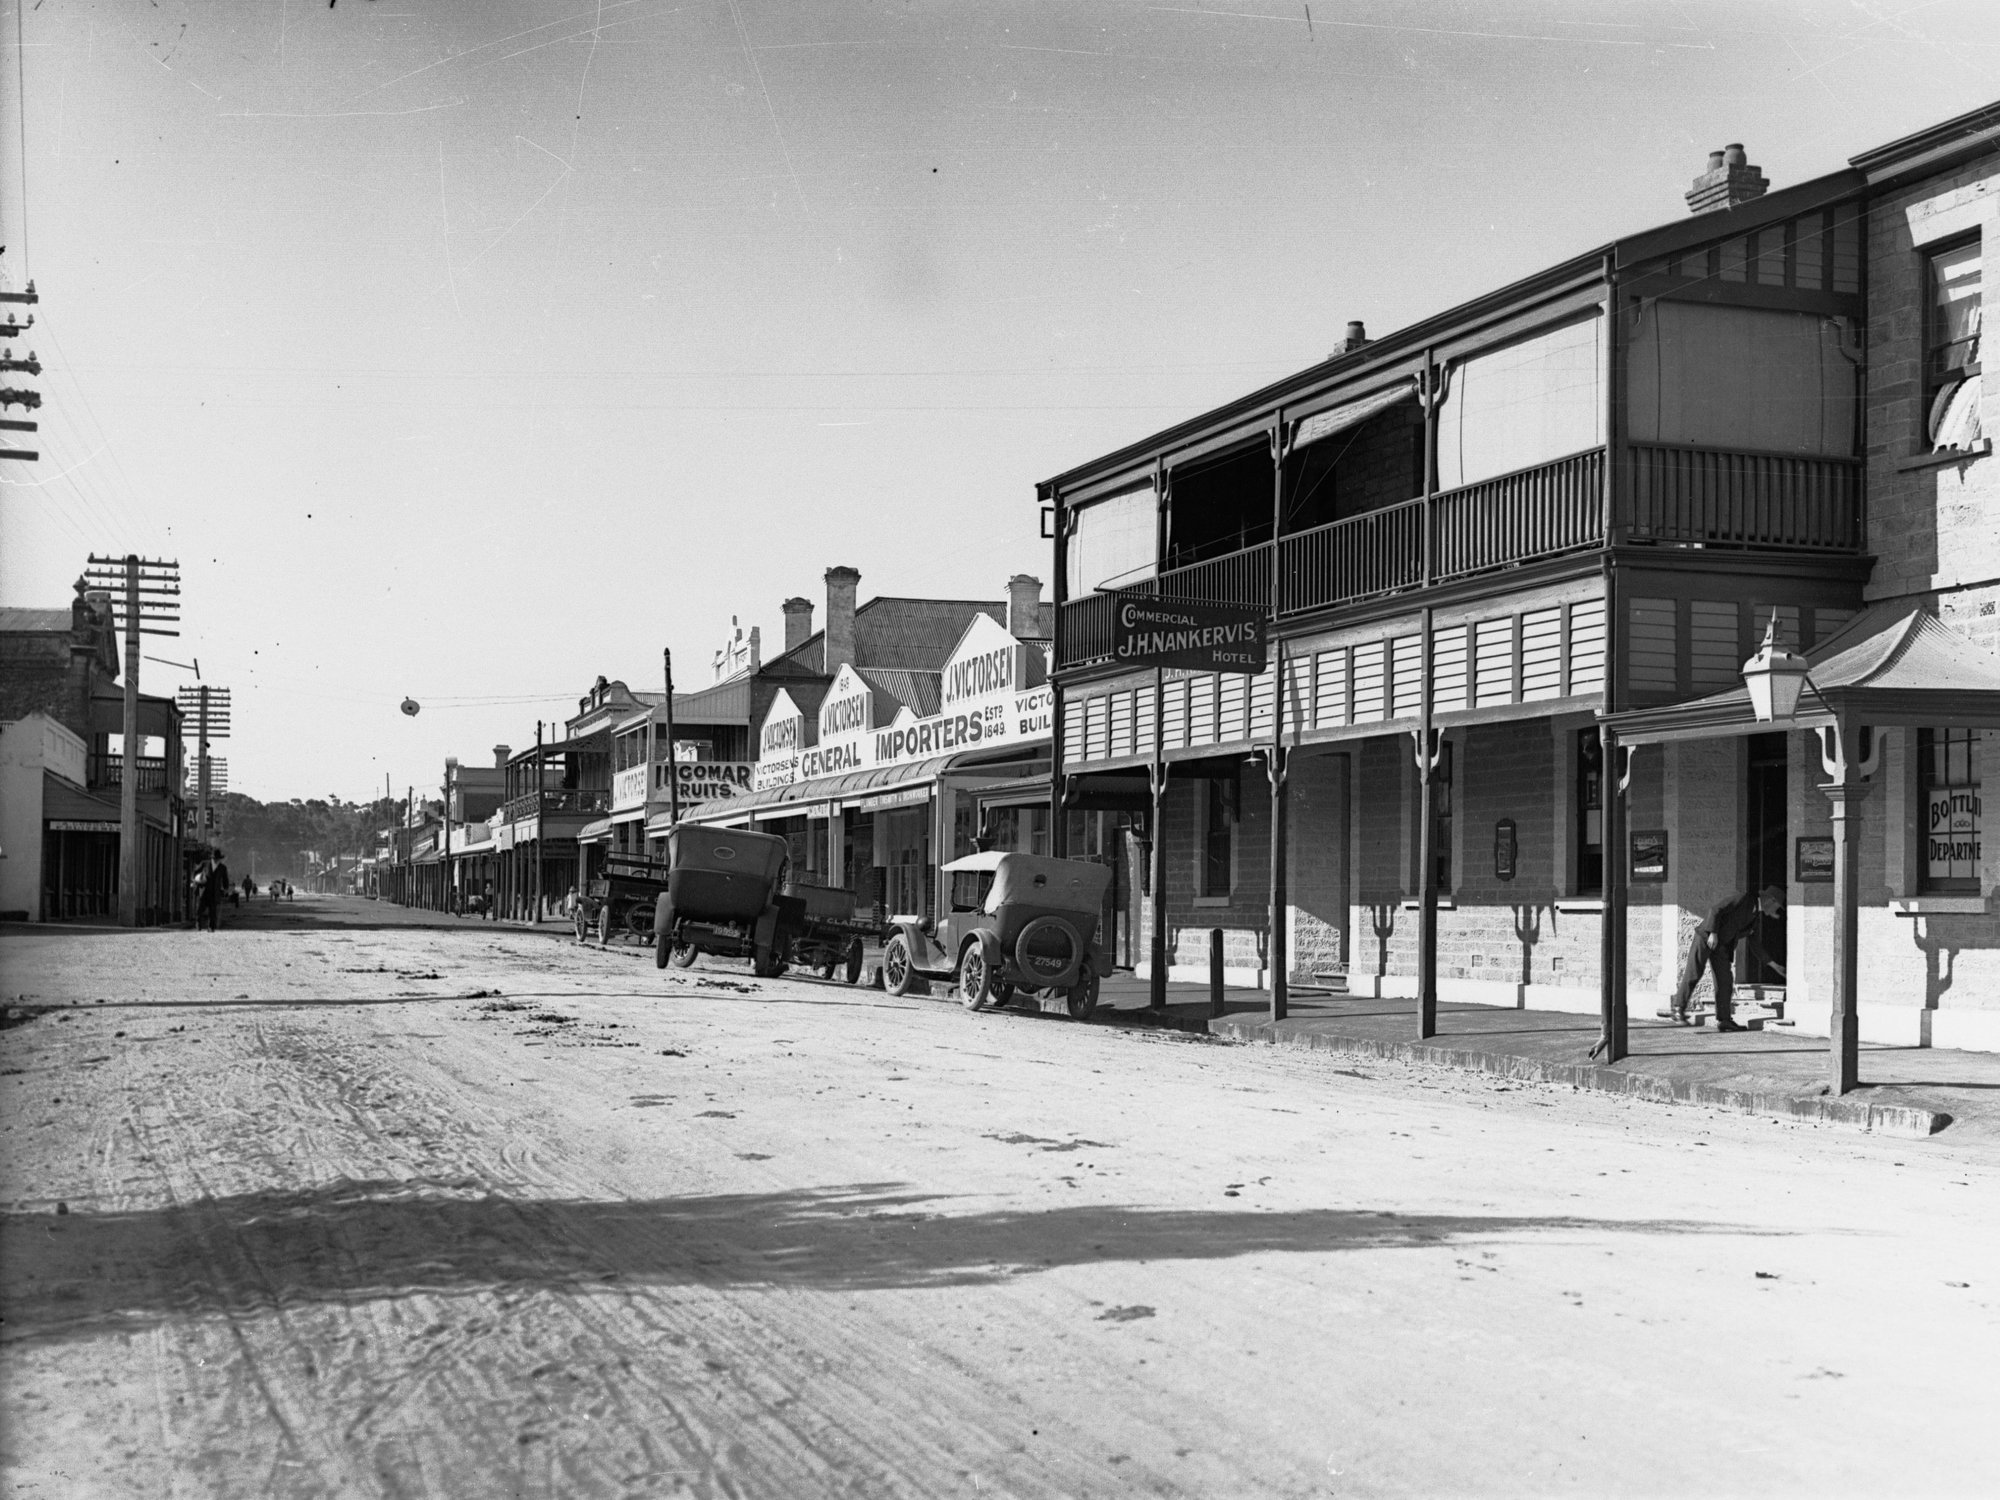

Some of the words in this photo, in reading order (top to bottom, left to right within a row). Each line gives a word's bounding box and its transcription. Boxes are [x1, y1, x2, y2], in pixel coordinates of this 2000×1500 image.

[1122, 603, 1198, 628] COMMERCIAL
[1213, 650, 1257, 664] HOTEL
[802, 741, 862, 778] GENERAL
[875, 711, 983, 761] IMPORTERS
[655, 765, 753, 792] INGOMAR
[1034, 956, 1062, 968] 27549
